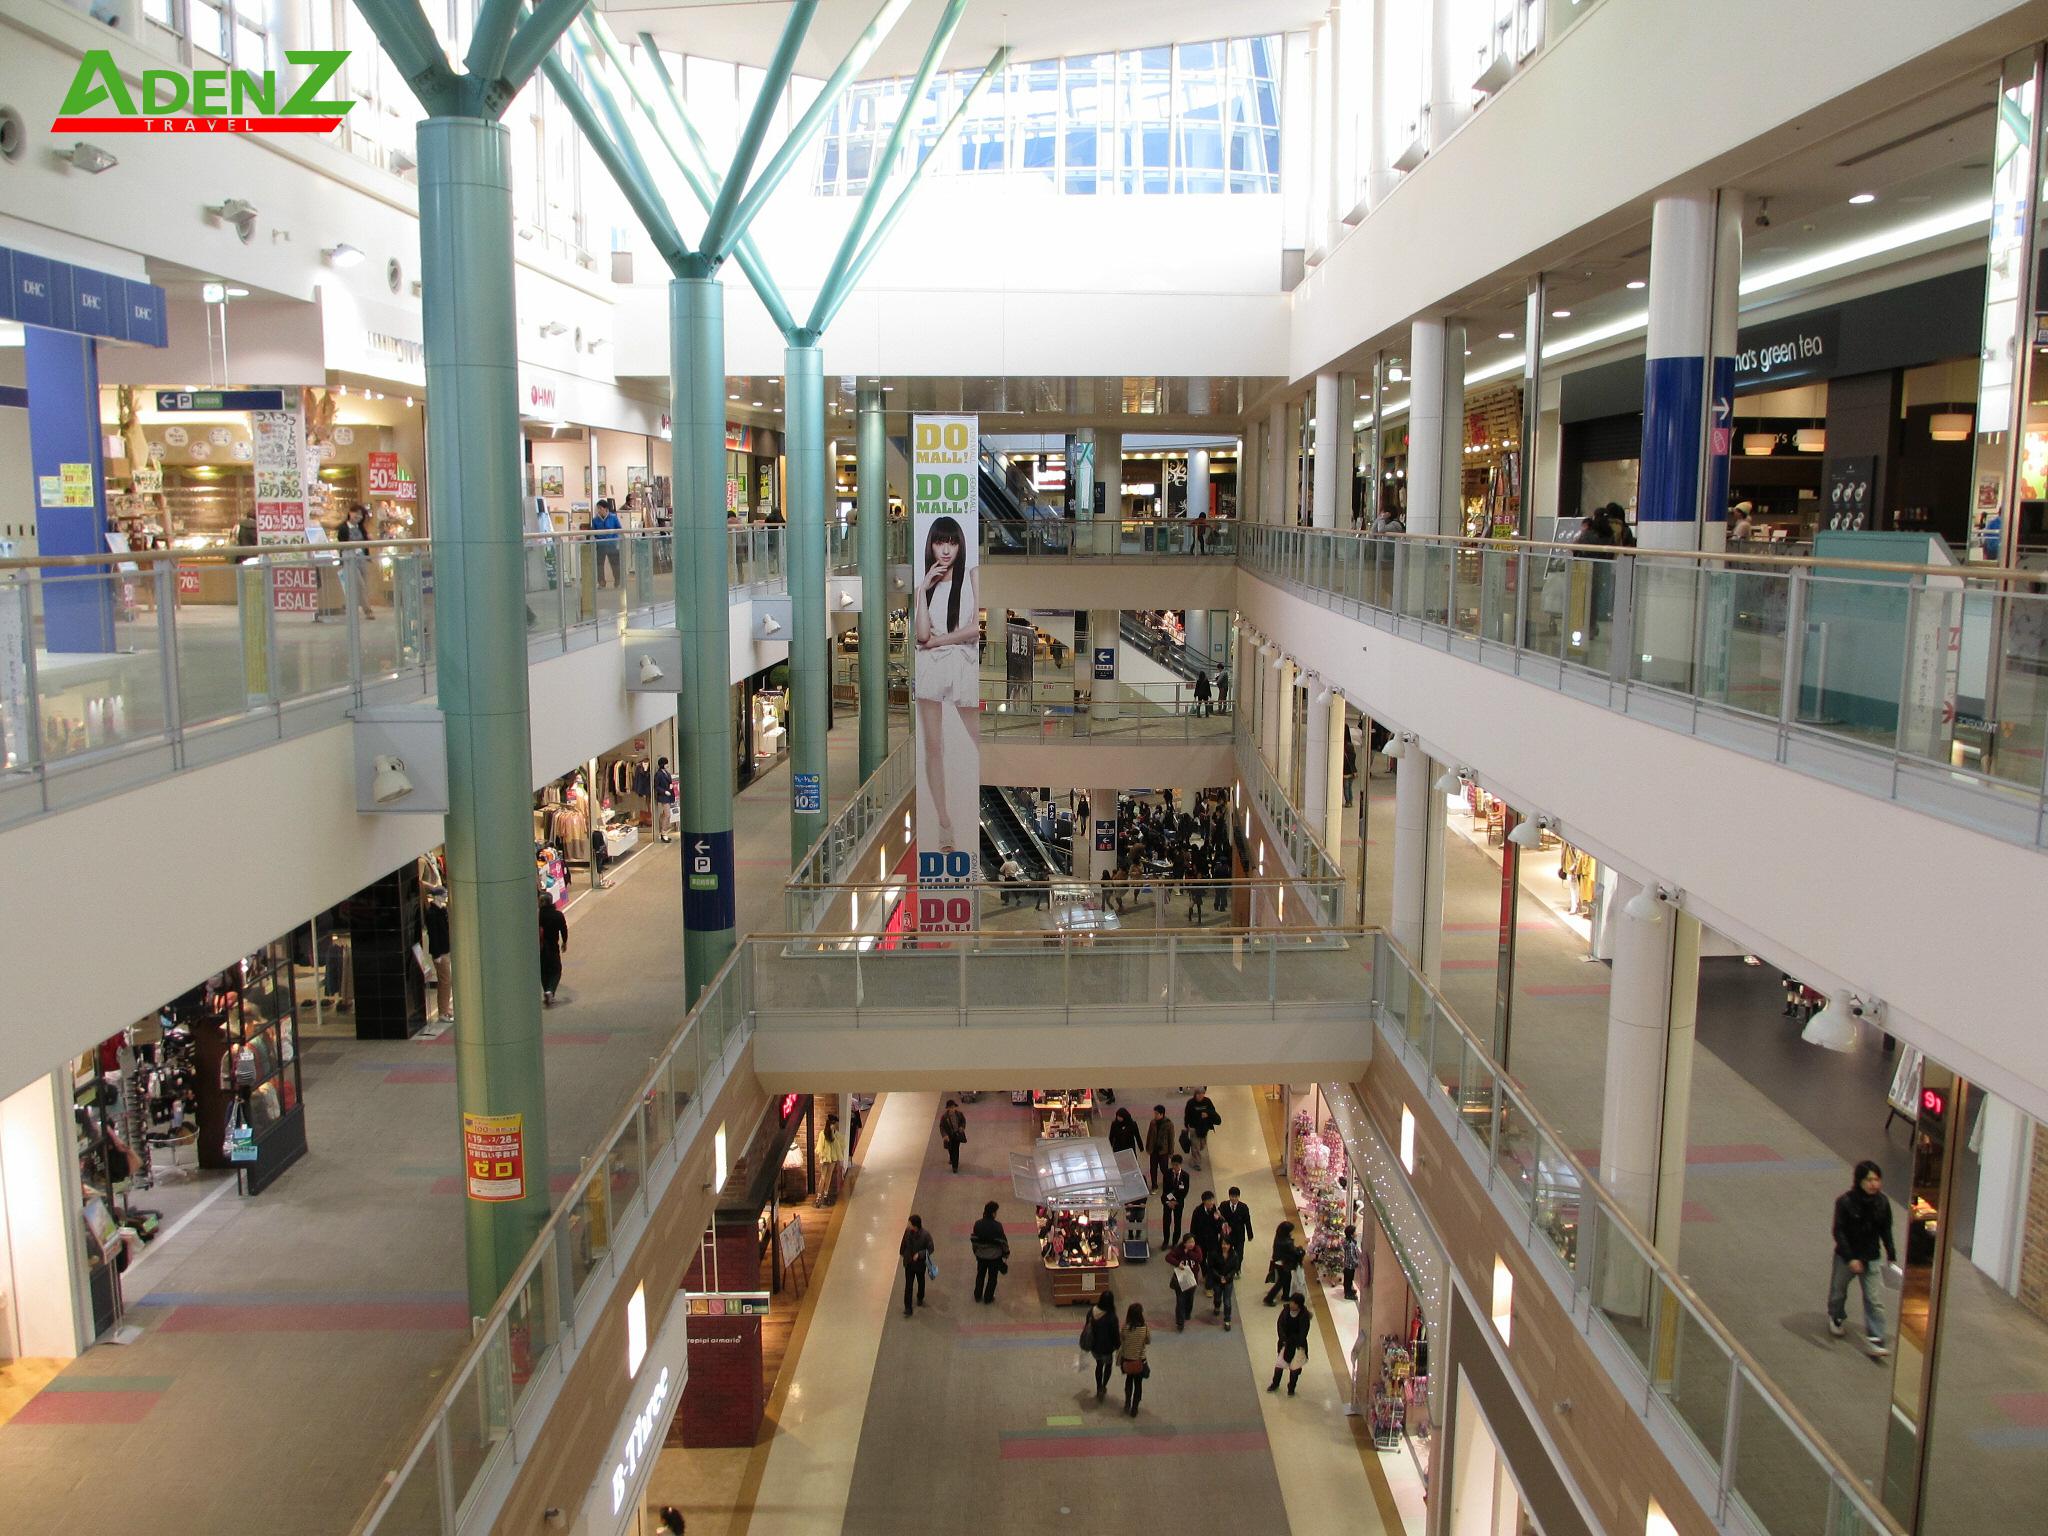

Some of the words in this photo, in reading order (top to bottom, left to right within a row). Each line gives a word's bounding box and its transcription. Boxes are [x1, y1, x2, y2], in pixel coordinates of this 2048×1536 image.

[24, 279, 45, 297] DHC
[82, 293, 100, 309] DHC
[135, 305, 152, 320] DHC
[1760, 342, 1797, 372] green
[1799, 334, 1823, 358] tea
[538, 386, 555, 408] HMV
[916, 424, 968, 450] DO
[916, 452, 968, 463] MALL!
[916, 474, 968, 500] DO
[916, 502, 968, 513] MALL!
[1049, 811, 1054, 819] 2
[698, 859, 708, 870] P
[919, 852, 970, 877] DO
[919, 898, 970, 923] DO
[474, 1160, 513, 1177] ゼロ
